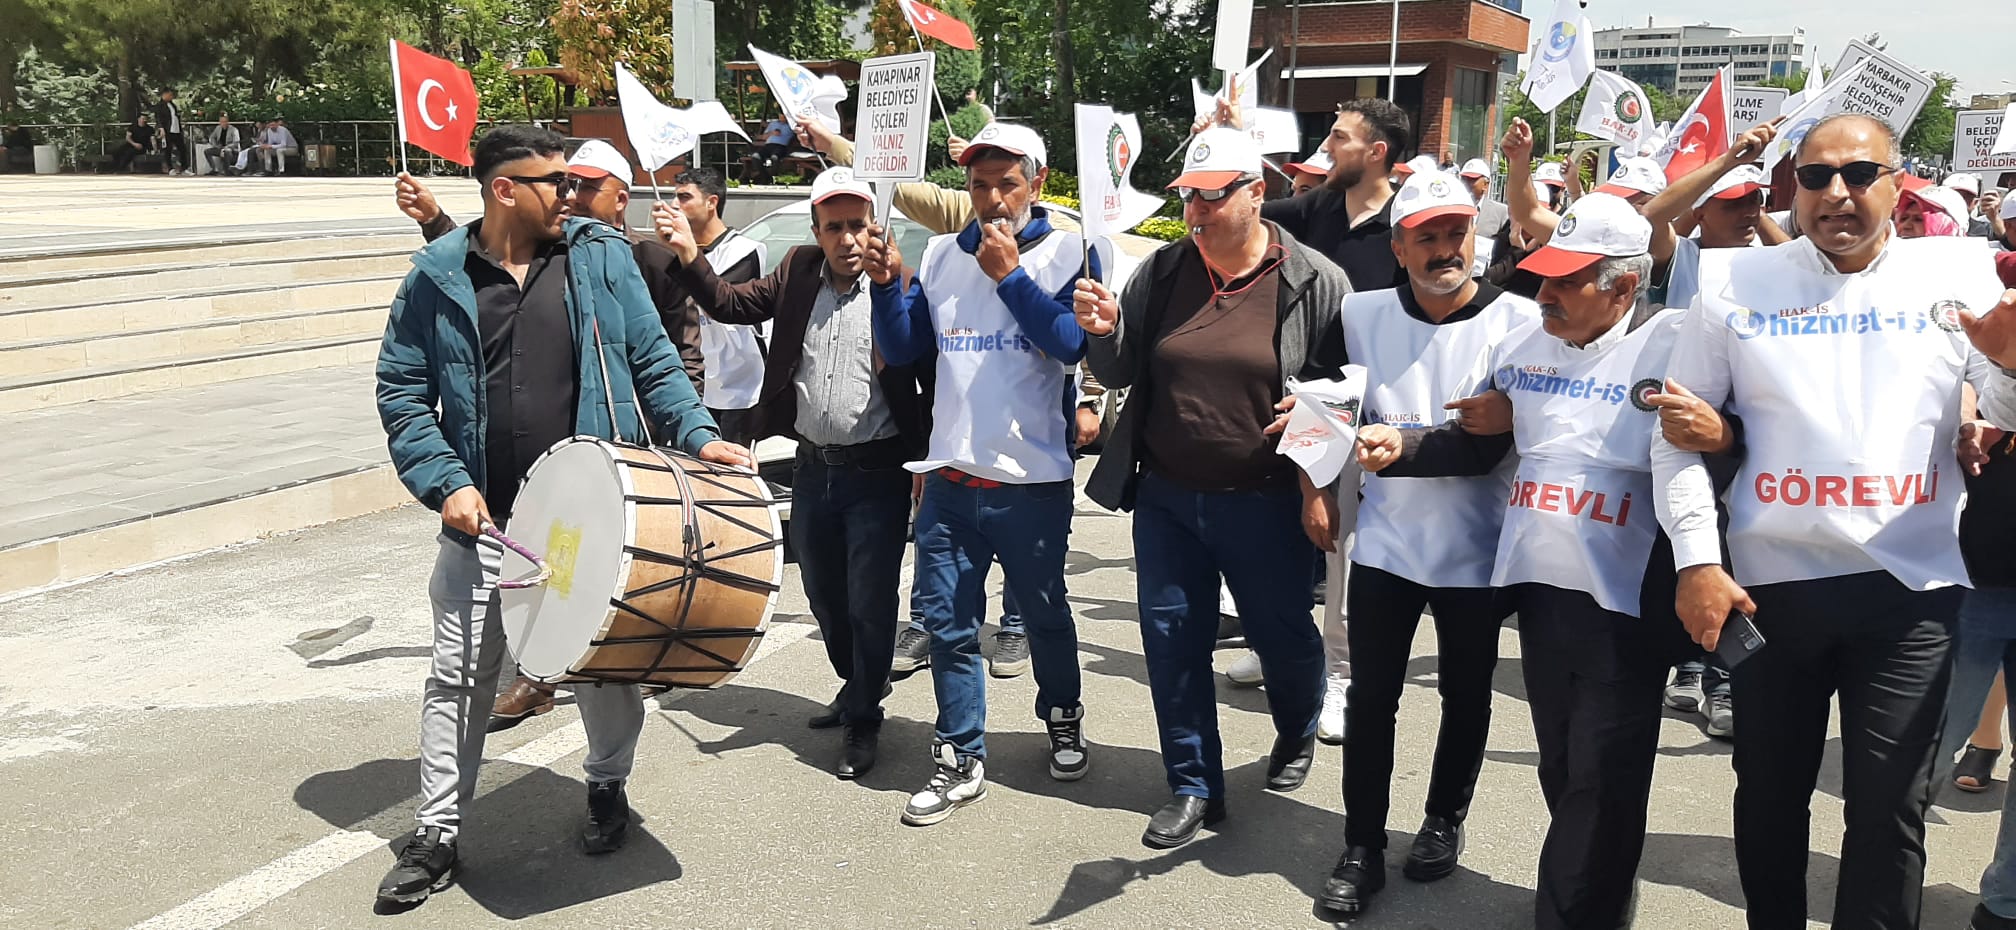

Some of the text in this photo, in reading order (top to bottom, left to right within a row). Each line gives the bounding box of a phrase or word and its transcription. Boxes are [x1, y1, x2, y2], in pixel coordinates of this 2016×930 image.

[867, 66, 921, 87] KAYAPINAR
[1856, 56, 1912, 93] YARBAKIR
[866, 85, 919, 108] BELEDİYESİ
[872, 108, 909, 133] İŞÇİLERİ
[1733, 110, 1759, 122] ARŞI
[872, 134, 905, 150] YALNIZ
[864, 151, 908, 172] DEĞİLDİR
[939, 329, 1032, 353] hizmet-iş
[1516, 368, 1627, 406] hizmet-iş
[1754, 463, 1940, 508] GÖREVLİ
[1509, 475, 1632, 527] ÖREVLİ
